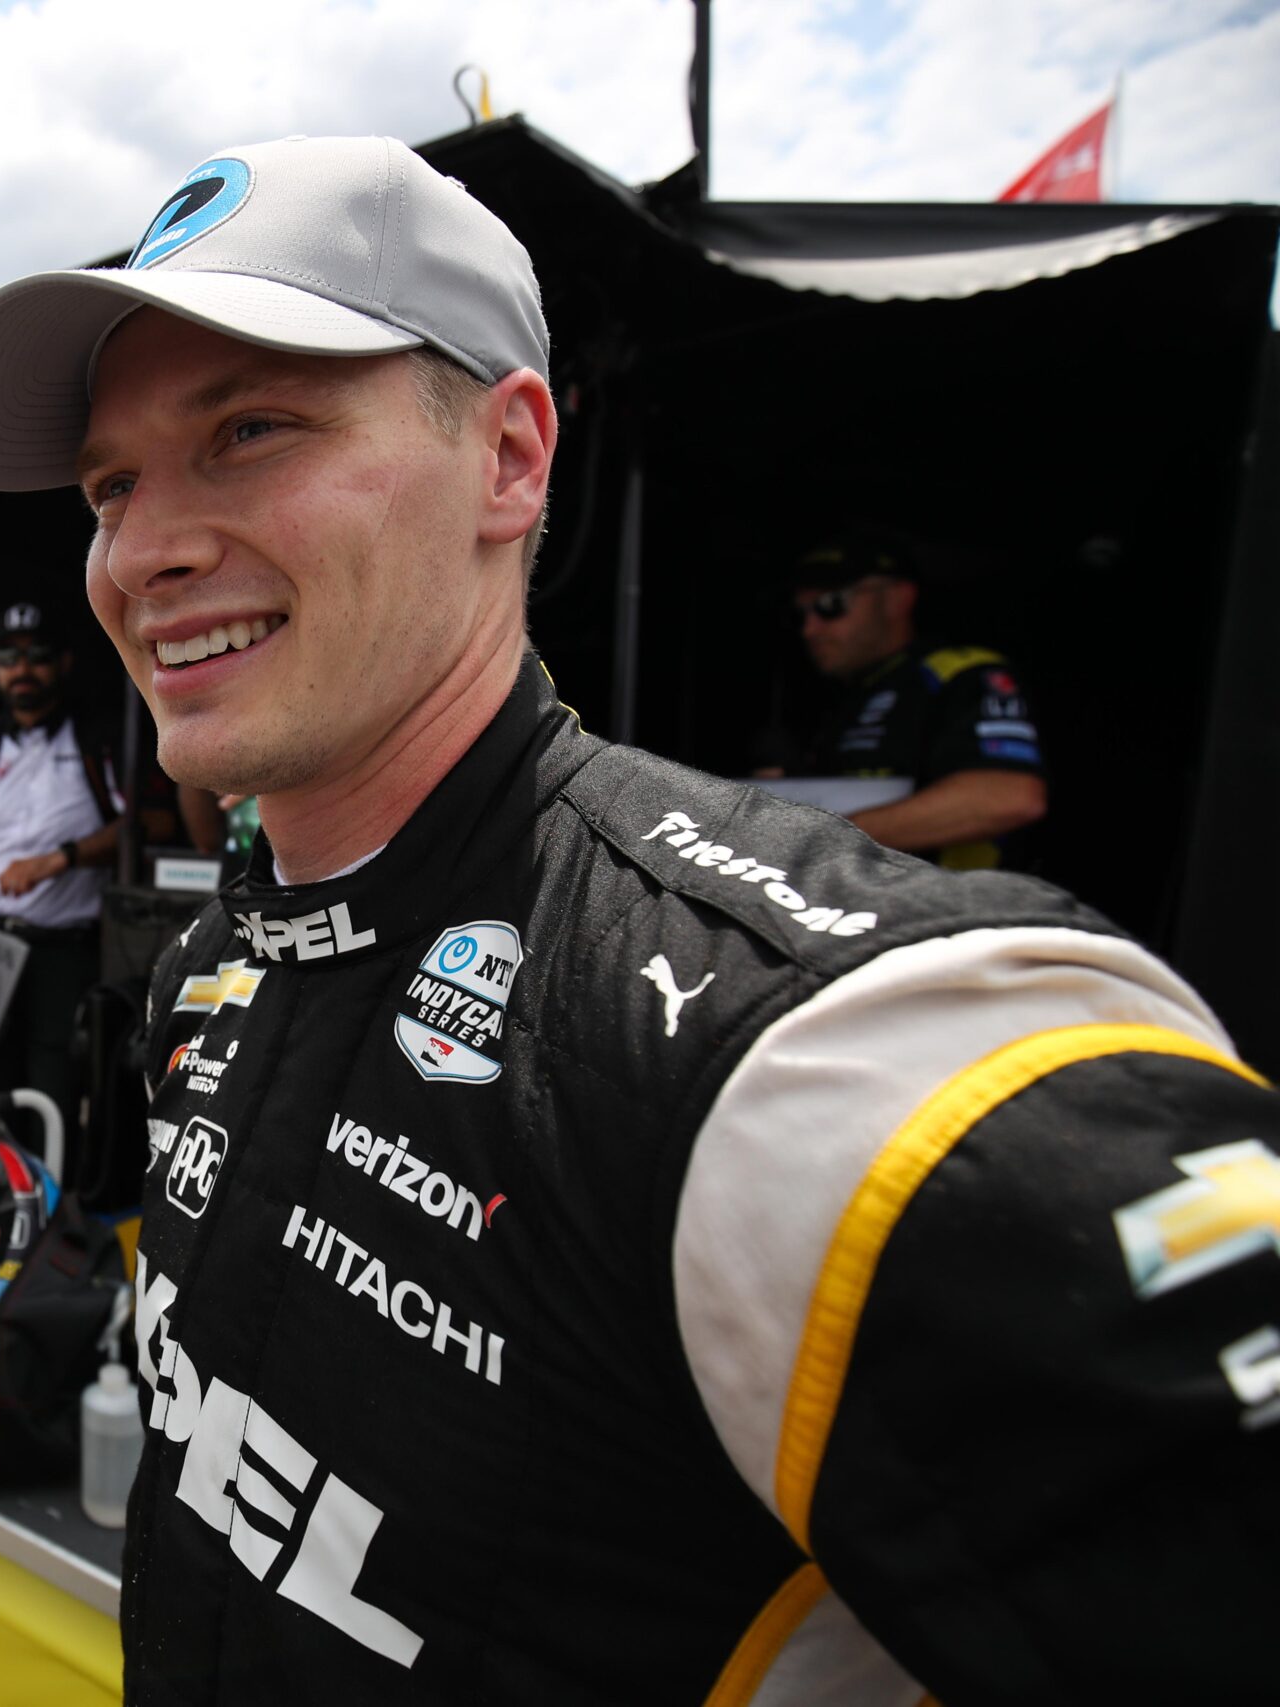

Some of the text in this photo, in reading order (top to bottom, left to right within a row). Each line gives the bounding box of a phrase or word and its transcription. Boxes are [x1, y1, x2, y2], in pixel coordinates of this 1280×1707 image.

[234, 901, 377, 962] XPEL
[641, 811, 879, 937] Firestone
[417, 1005, 488, 1048] SERIES
[171, 1128, 222, 1199] PPG
[326, 1112, 484, 1241] verizon
[282, 1205, 505, 1386] HITACHI
[136, 1248, 425, 1670] XPEL
